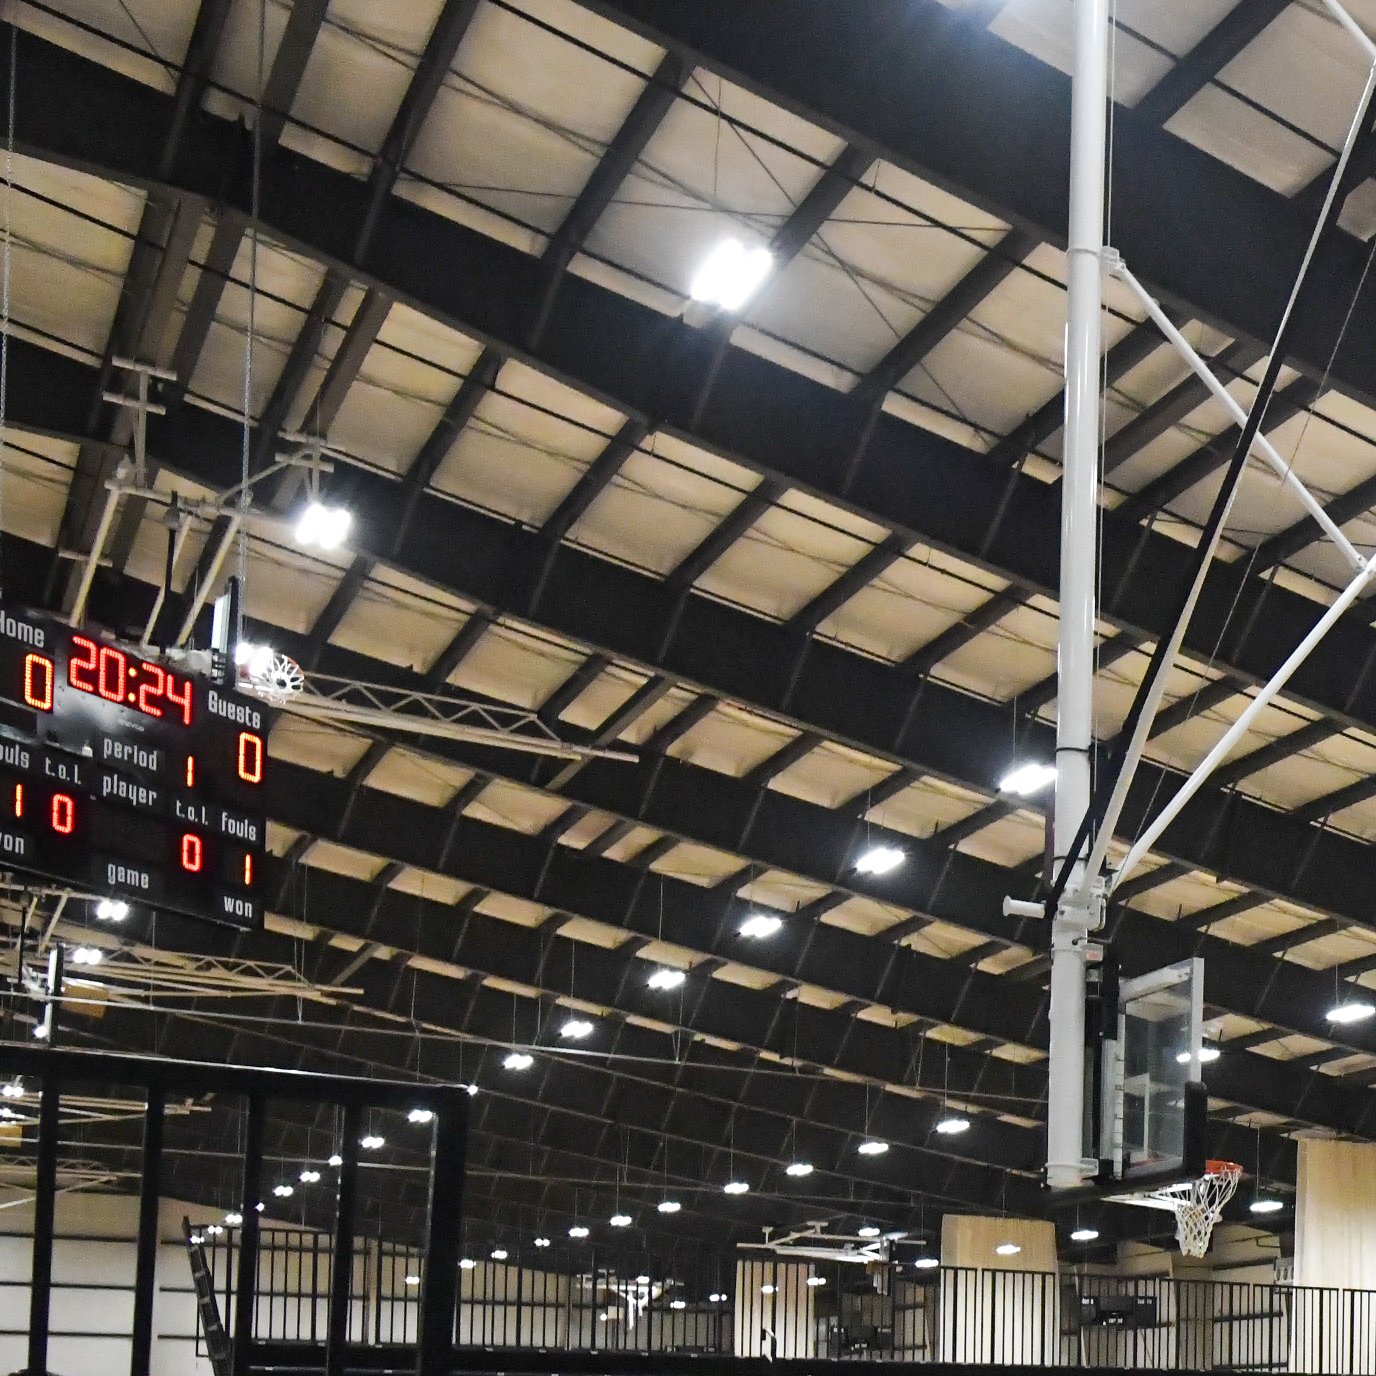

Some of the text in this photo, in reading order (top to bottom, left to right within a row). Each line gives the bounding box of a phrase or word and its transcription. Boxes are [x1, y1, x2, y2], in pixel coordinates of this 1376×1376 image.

[24, 653, 54, 711] 0
[69, 635, 192, 726] 20:24
[207, 689, 261, 730] Guests
[103, 737, 157, 771] period
[238, 731, 262, 784] 0
[186, 755, 194, 788] 1
[15, 783, 23, 818] 1
[102, 774, 157, 807] player
[52, 793, 73, 834] 0
[221, 811, 257, 841] fouls
[182, 833, 202, 872] 0
[244, 853, 252, 886] 1
[107, 863, 150, 890] game
[223, 895, 253, 918] won
